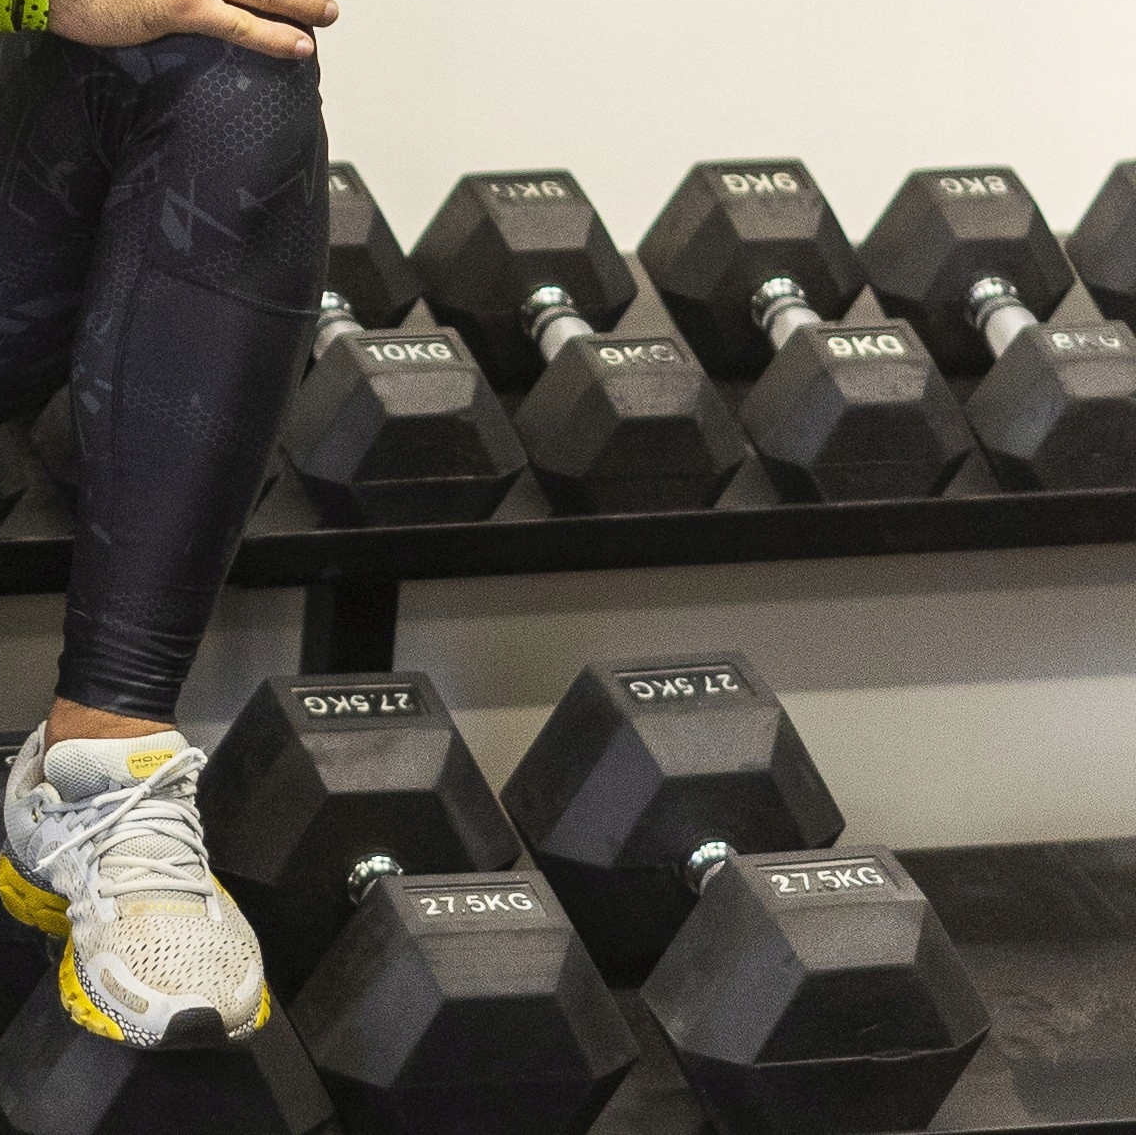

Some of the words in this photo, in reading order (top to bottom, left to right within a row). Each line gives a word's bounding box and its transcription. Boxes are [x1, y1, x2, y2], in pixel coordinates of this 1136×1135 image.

[721, 172, 798, 194] 9KG
[939, 175, 1008, 195] 8KG
[366, 342, 452, 362] 10KG
[629, 673, 739, 699] 27.5KG
[303, 693, 412, 715] 27.5KG
[419, 892, 533, 915] 27.5KG
